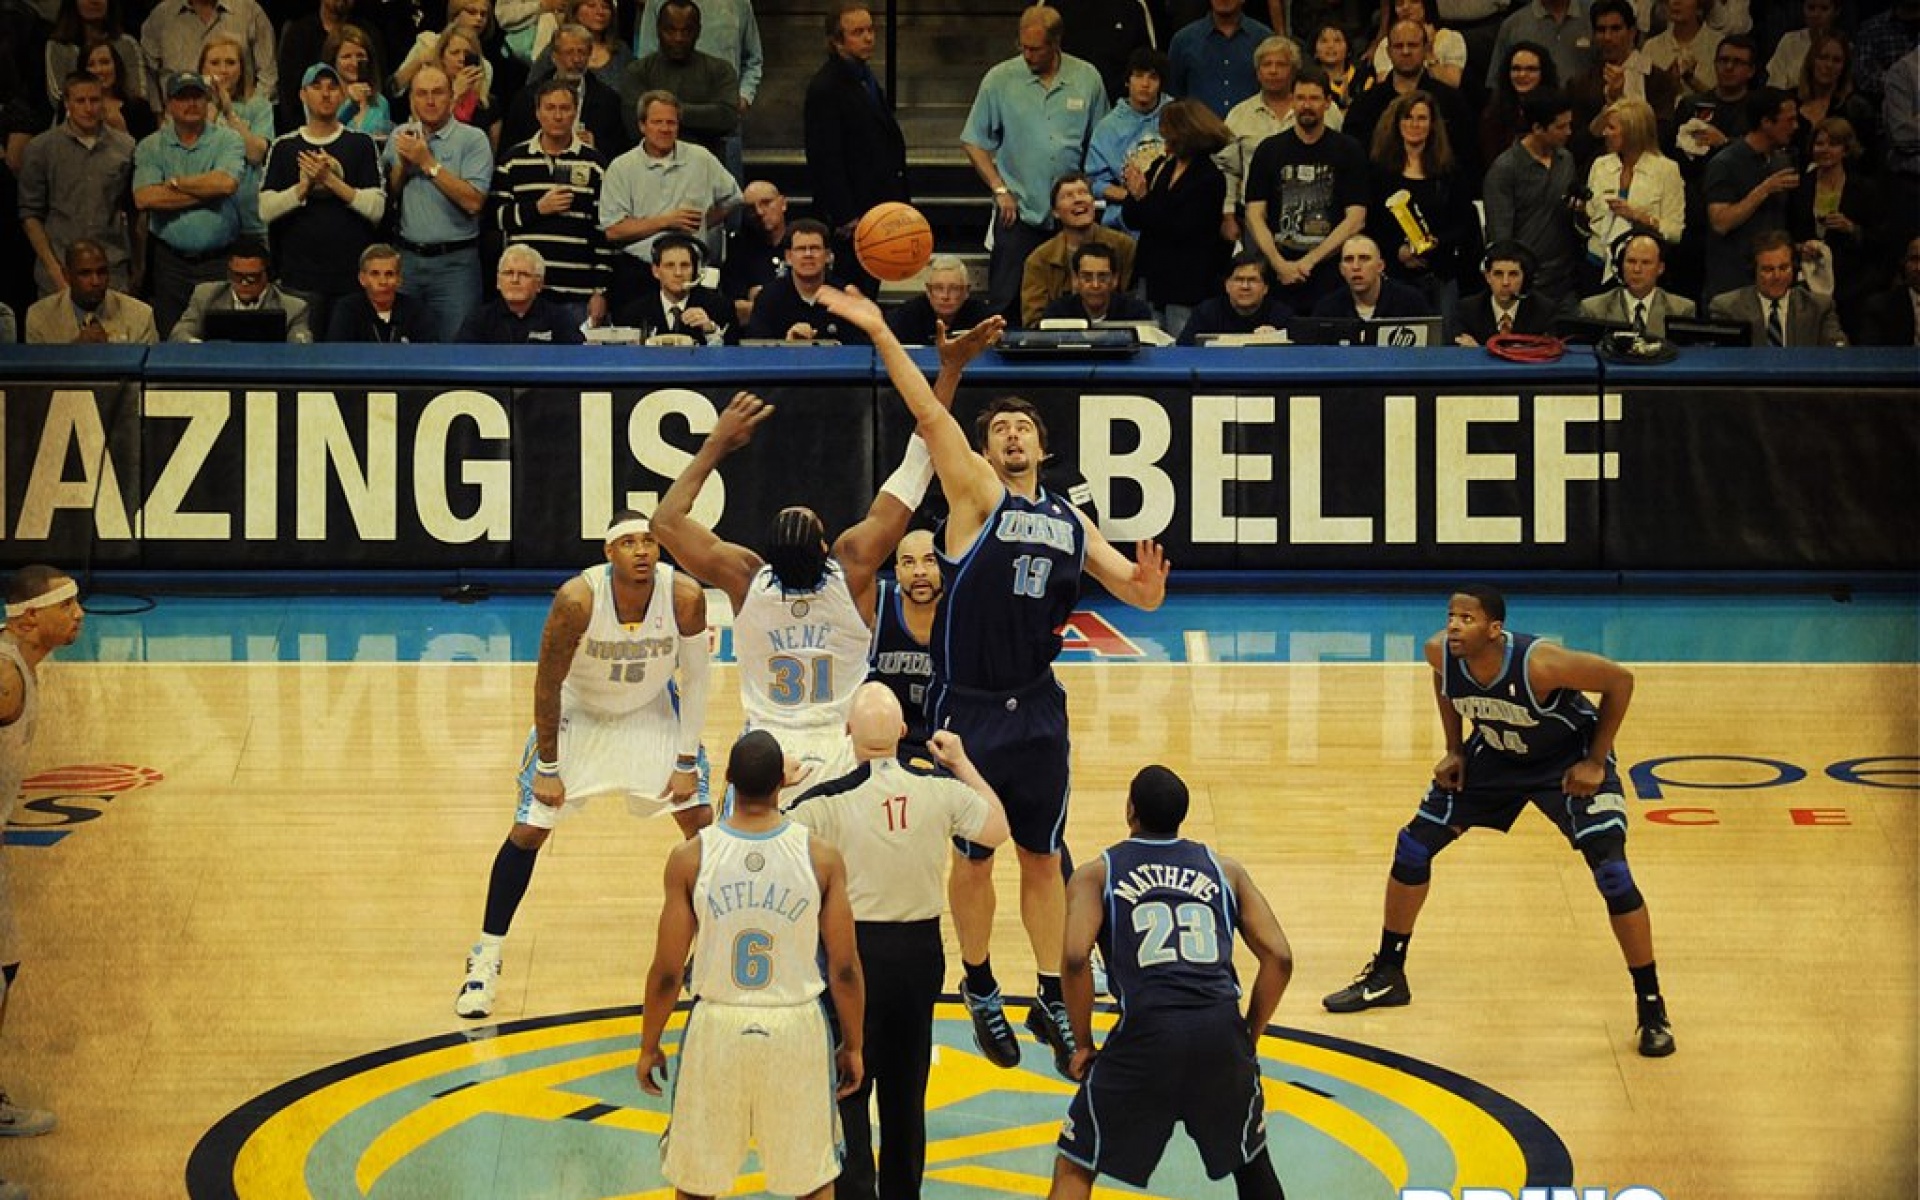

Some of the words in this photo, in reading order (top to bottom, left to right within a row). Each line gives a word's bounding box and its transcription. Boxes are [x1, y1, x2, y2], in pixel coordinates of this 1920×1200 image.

[0, 388, 512, 544] AZING
[1078, 394, 1622, 544] BELIEF
[1013, 554, 1053, 598] 13
[609, 661, 646, 683] 15
[768, 654, 834, 705] 31
[882, 796, 909, 832] 17
[707, 880, 810, 923] AFFLALO
[1113, 863, 1220, 904] MATTHEWS
[1131, 901, 1220, 968] 23
[731, 928, 774, 990] 6
